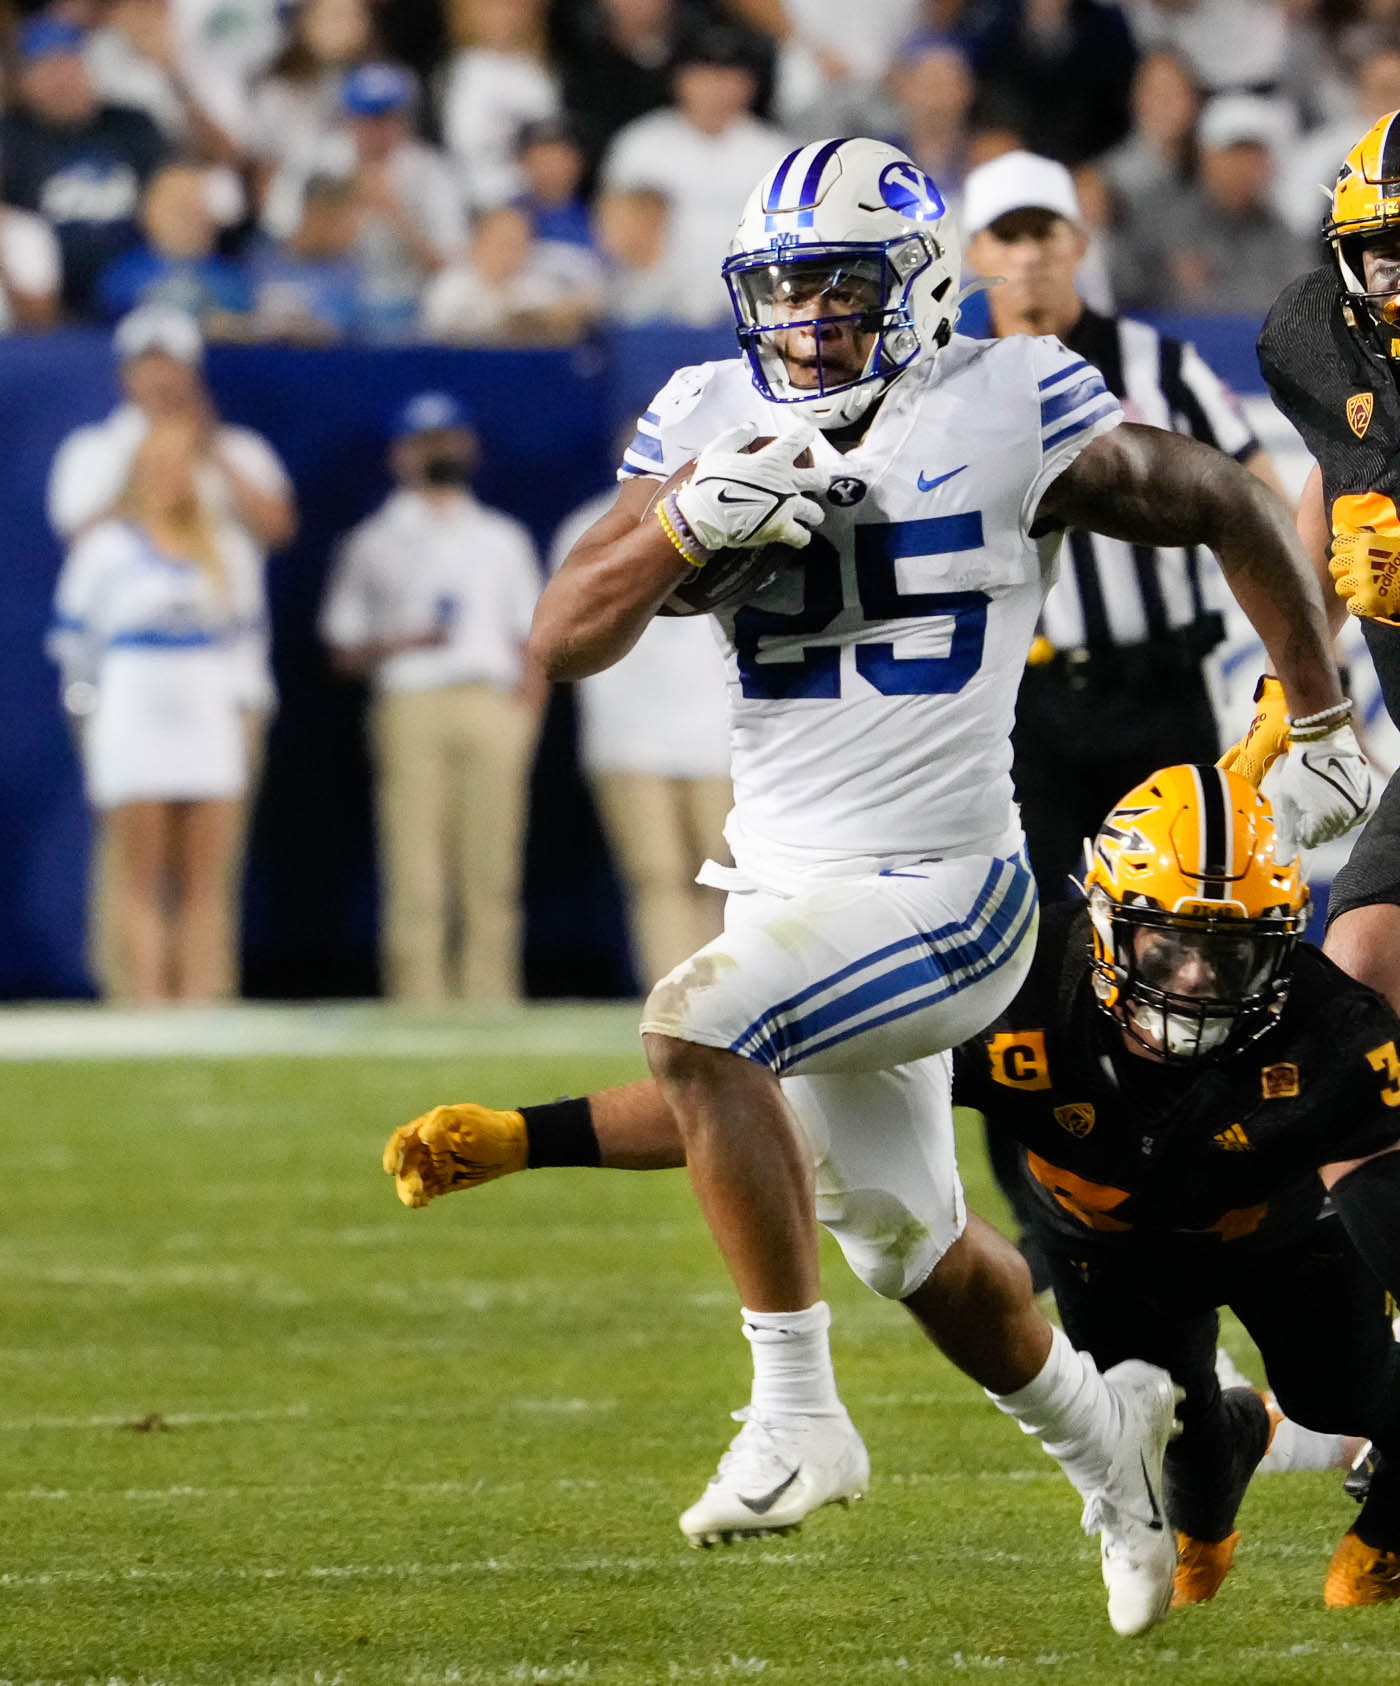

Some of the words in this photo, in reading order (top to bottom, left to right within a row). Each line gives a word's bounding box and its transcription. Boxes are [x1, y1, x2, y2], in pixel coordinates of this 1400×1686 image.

[1354, 411, 1368, 429] 12
[733, 510, 994, 701] 25
[1003, 1044, 1038, 1082] C
